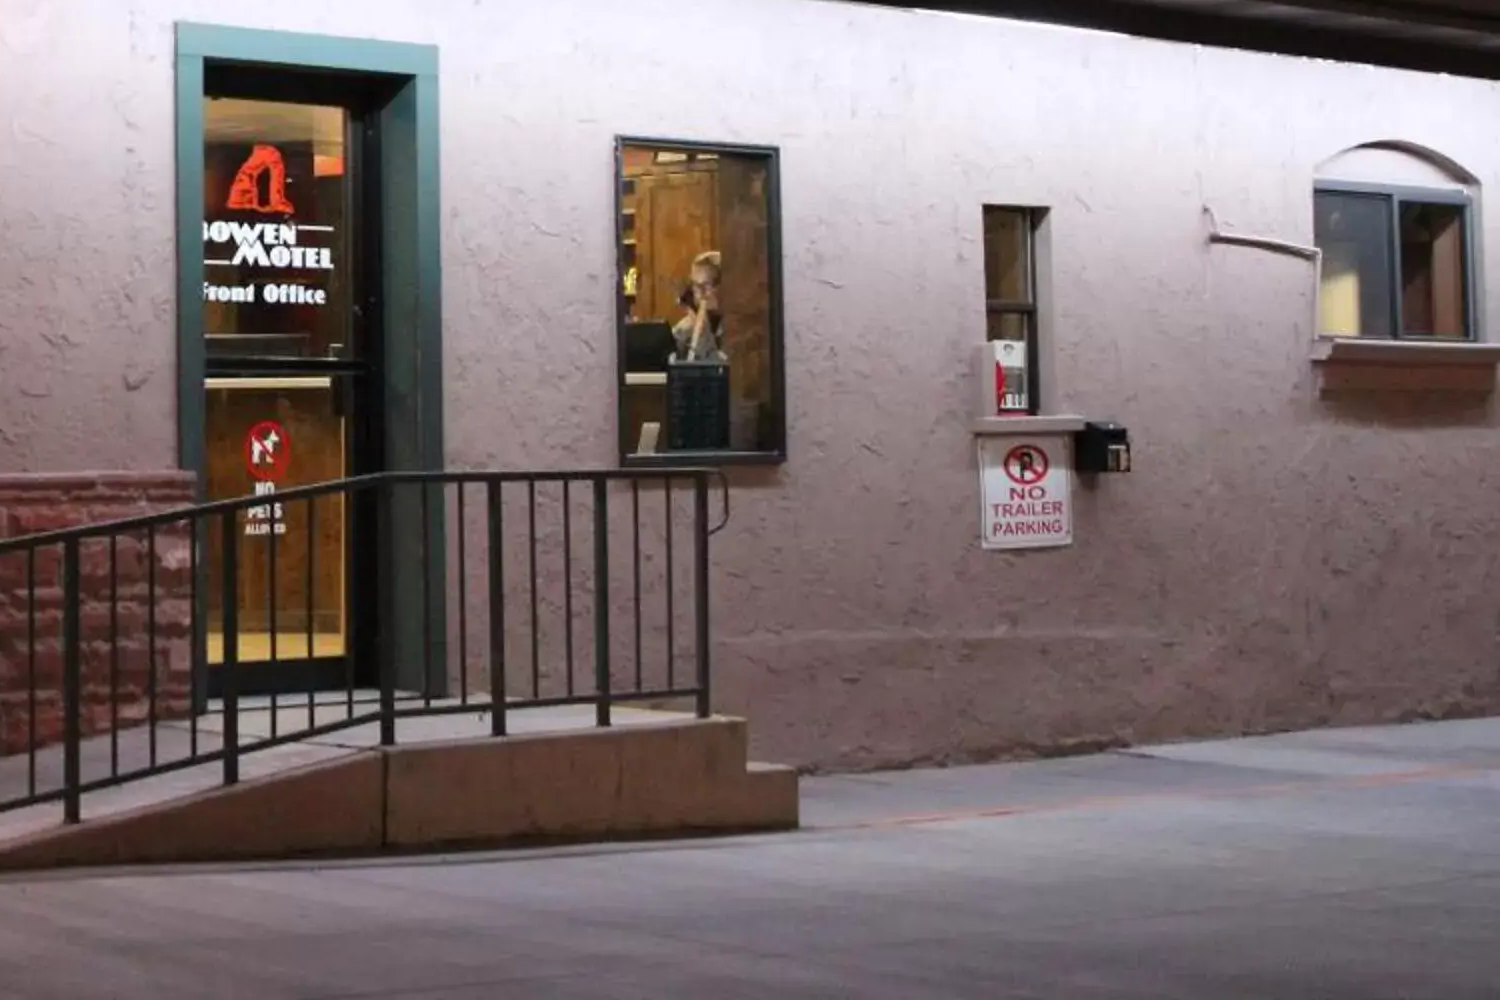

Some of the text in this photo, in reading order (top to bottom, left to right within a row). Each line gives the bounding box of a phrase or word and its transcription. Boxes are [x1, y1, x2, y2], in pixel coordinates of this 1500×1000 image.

[231, 240, 335, 269] MOTEL
[263, 283, 327, 305] Office
[1009, 485, 1046, 501] NO
[991, 501, 1063, 518] TRAILER
[993, 519, 1063, 537] PARKING
